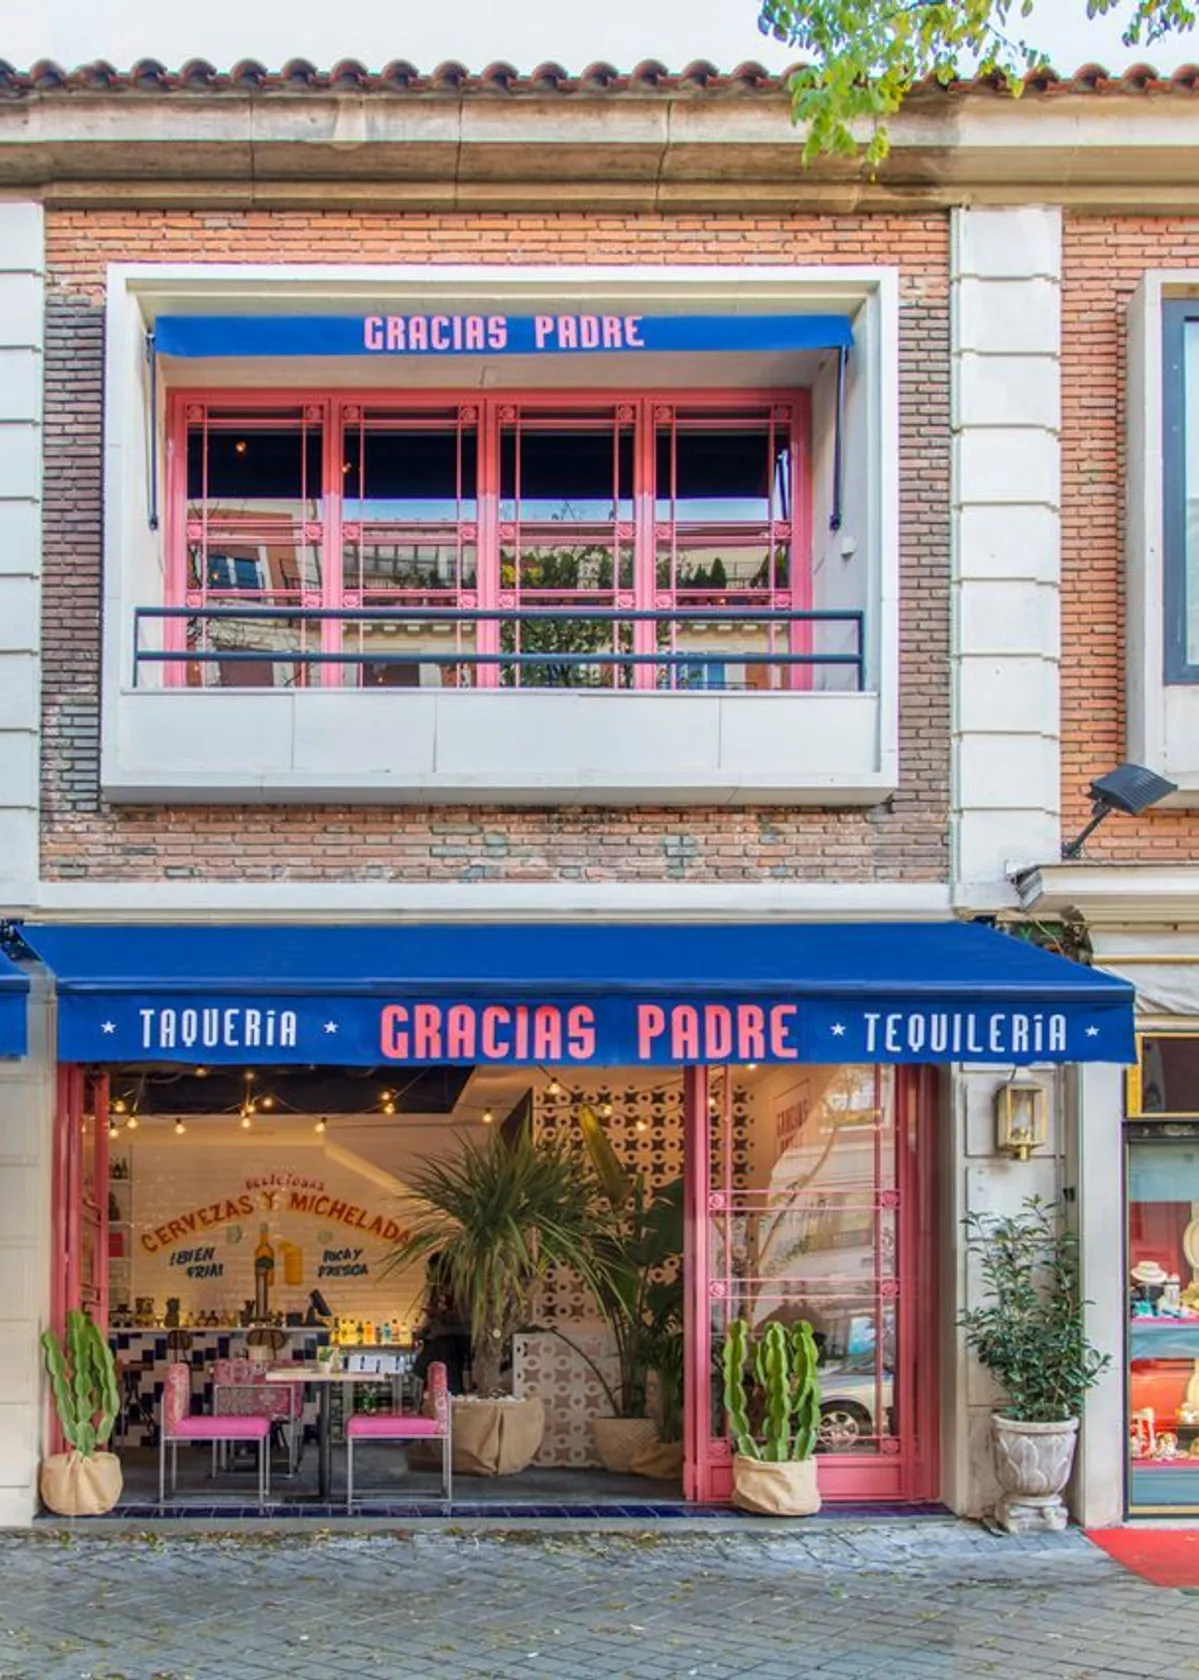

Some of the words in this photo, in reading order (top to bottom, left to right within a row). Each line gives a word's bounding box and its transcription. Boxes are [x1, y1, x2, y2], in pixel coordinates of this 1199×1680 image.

[364, 315, 507, 350] GRACIAS
[534, 314, 644, 348] PADRE
[380, 1003, 596, 1060] GRACIAS
[637, 1003, 798, 1059] PADRE
[140, 1195, 255, 1254] CERVEZAS
[262, 1191, 276, 1210] Y
[289, 1191, 412, 1245] MICHELADA
